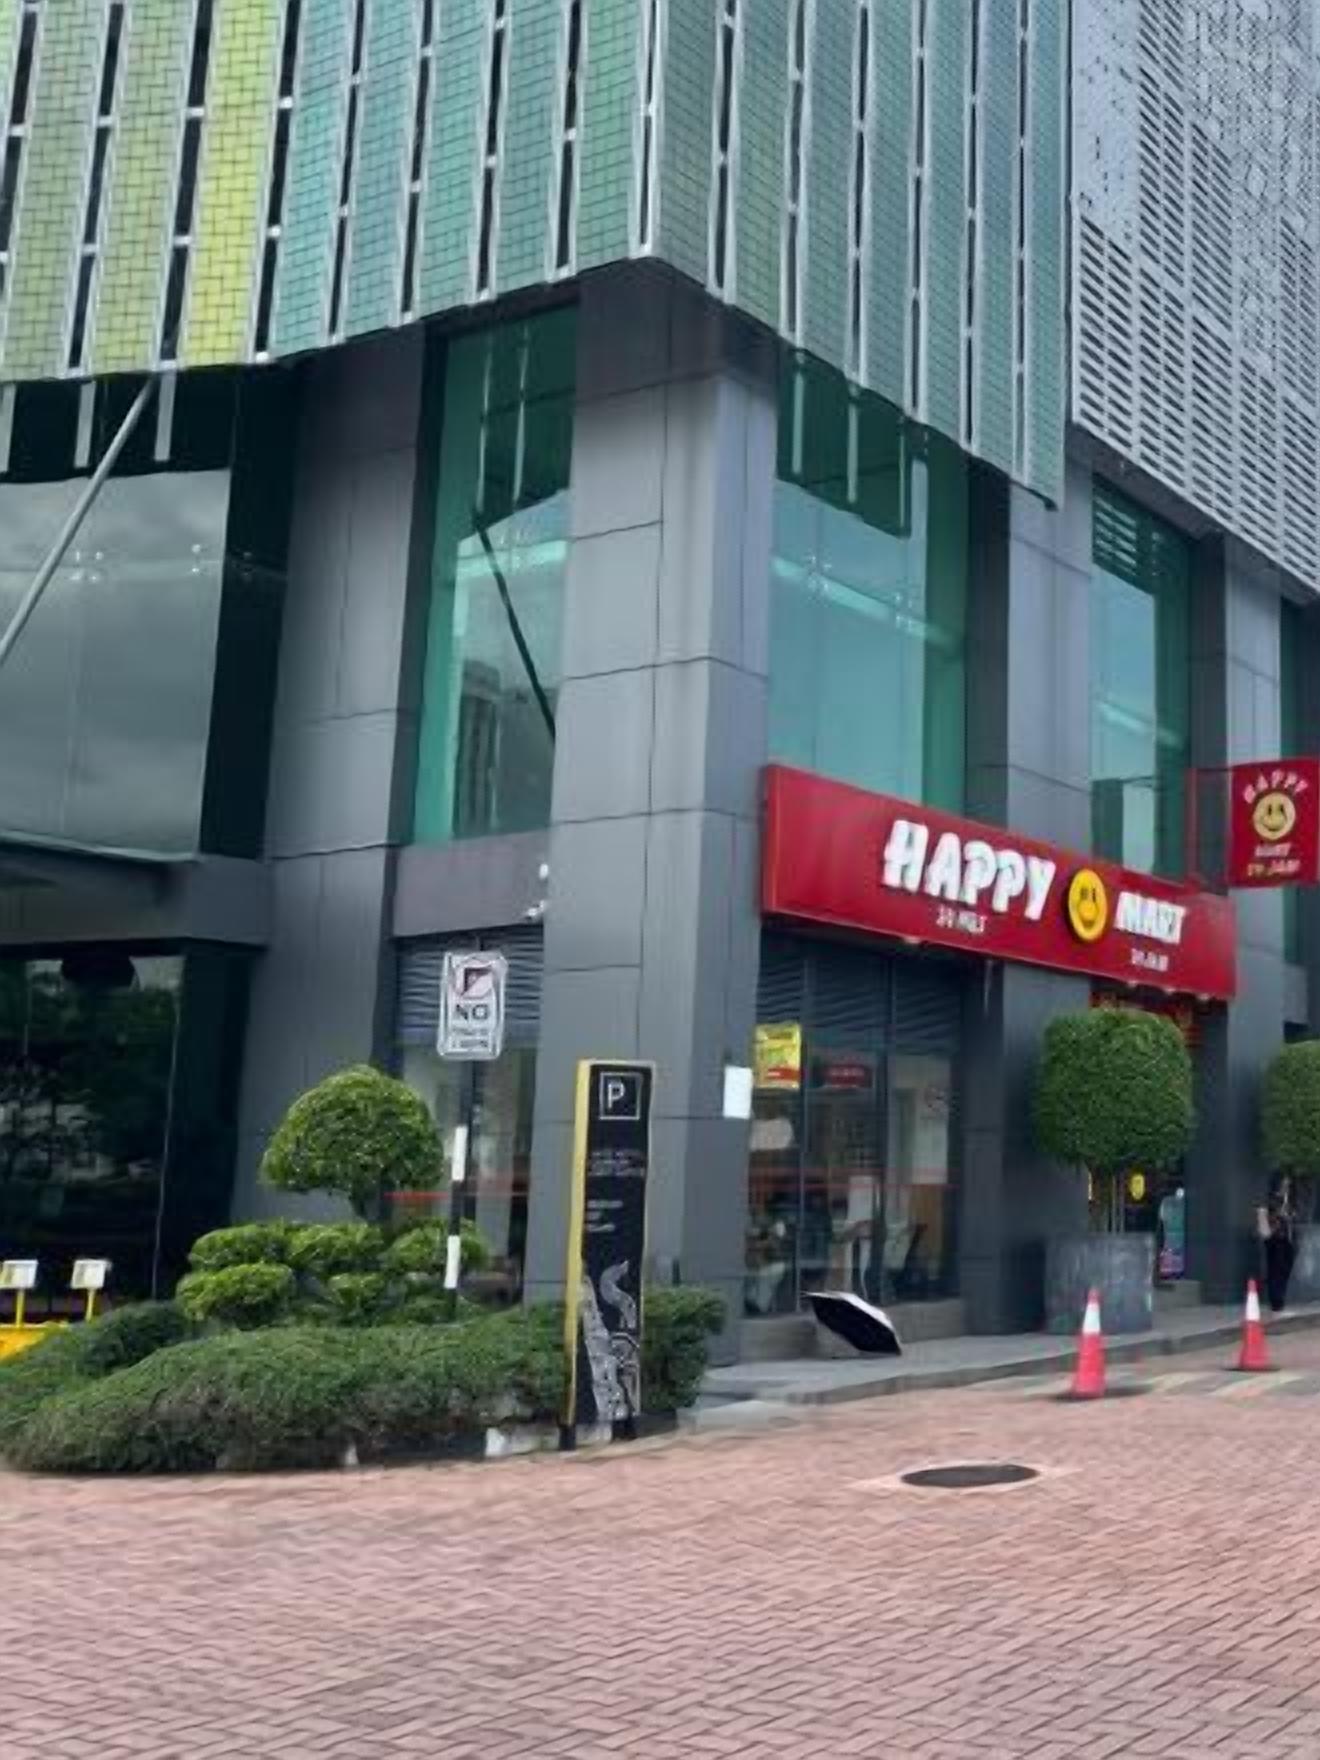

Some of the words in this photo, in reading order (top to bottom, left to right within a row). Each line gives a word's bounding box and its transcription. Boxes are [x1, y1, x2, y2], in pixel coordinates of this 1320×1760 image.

[883, 819, 1057, 922] HAPPY
[455, 1004, 489, 1021] NO
[606, 1081, 626, 1109] P
